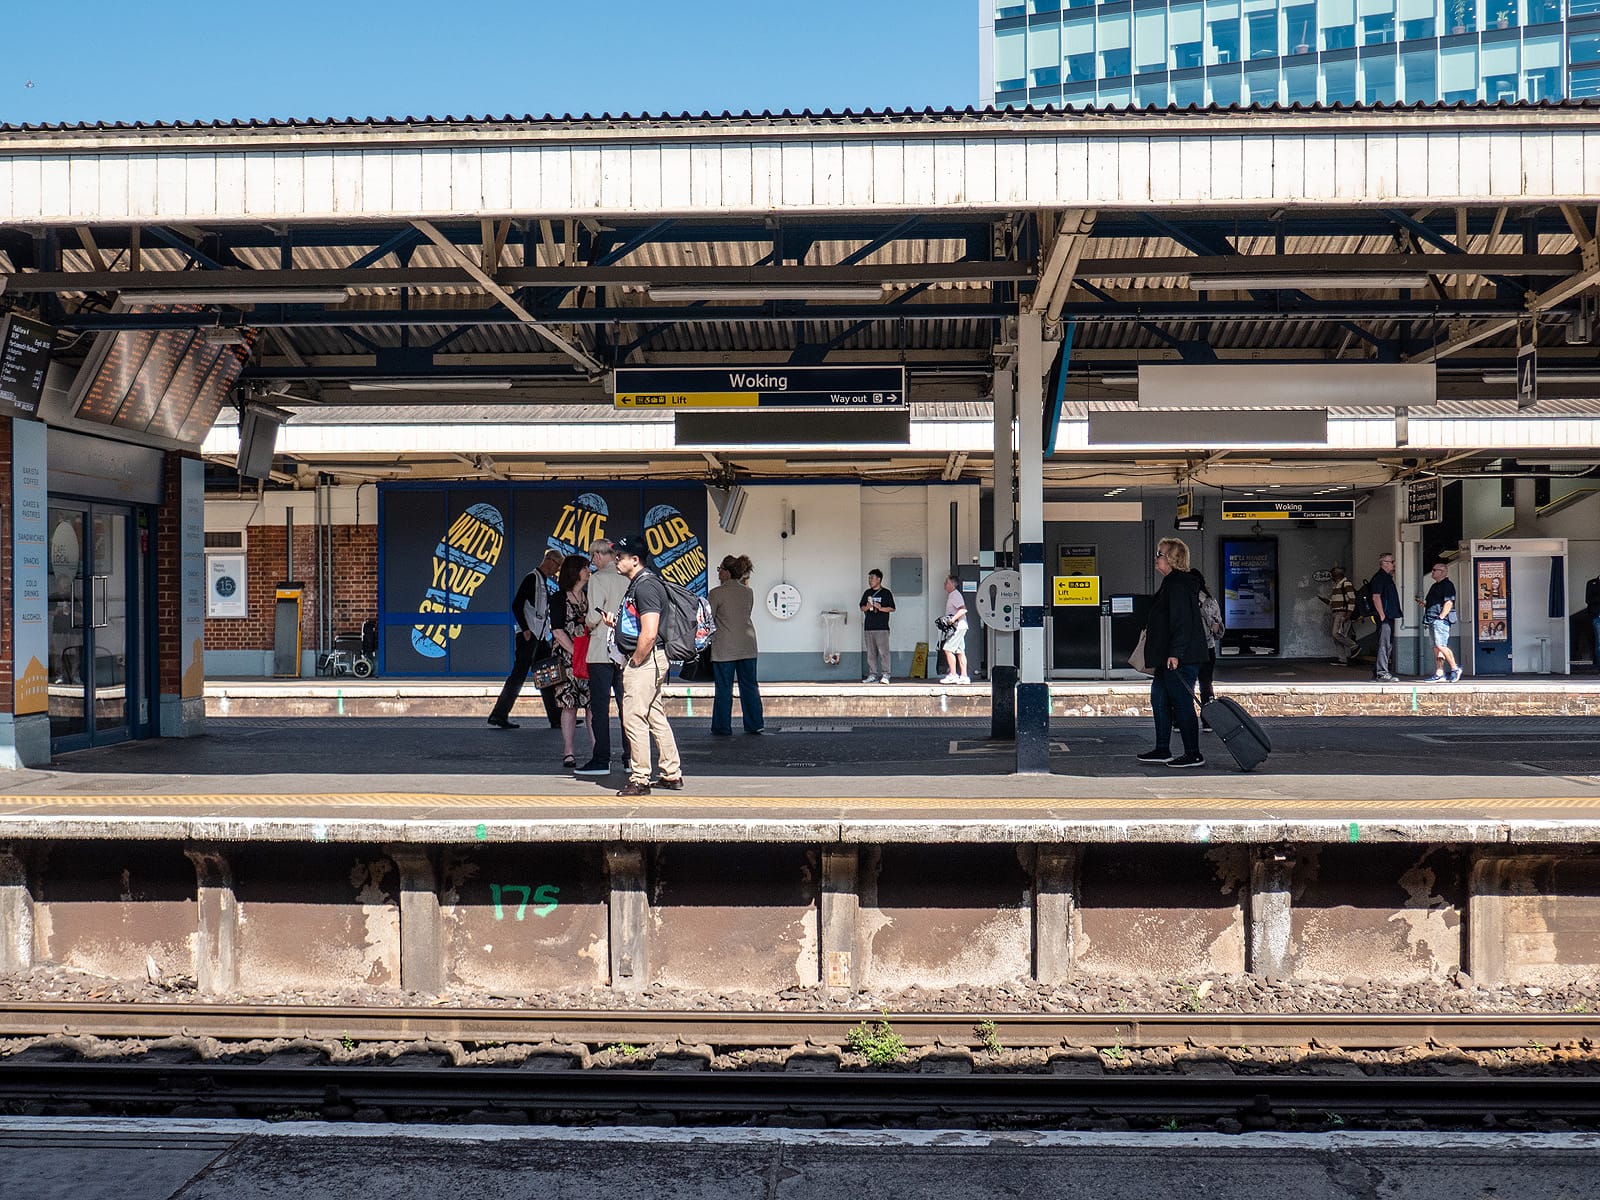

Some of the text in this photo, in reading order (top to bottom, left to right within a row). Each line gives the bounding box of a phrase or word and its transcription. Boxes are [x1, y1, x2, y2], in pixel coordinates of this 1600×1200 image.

[729, 373, 788, 390] Woking
[830, 394, 868, 404] Way out
[1522, 360, 1532, 399] 4
[672, 395, 687, 405] Lift
[1275, 503, 1303, 511] Woking
[441, 511, 503, 566] WATCH
[552, 504, 608, 552] TAKE
[645, 517, 695, 556] OUR
[220, 579, 233, 591] 15
[432, 556, 486, 597] YOUR
[661, 545, 706, 587] STATIONS
